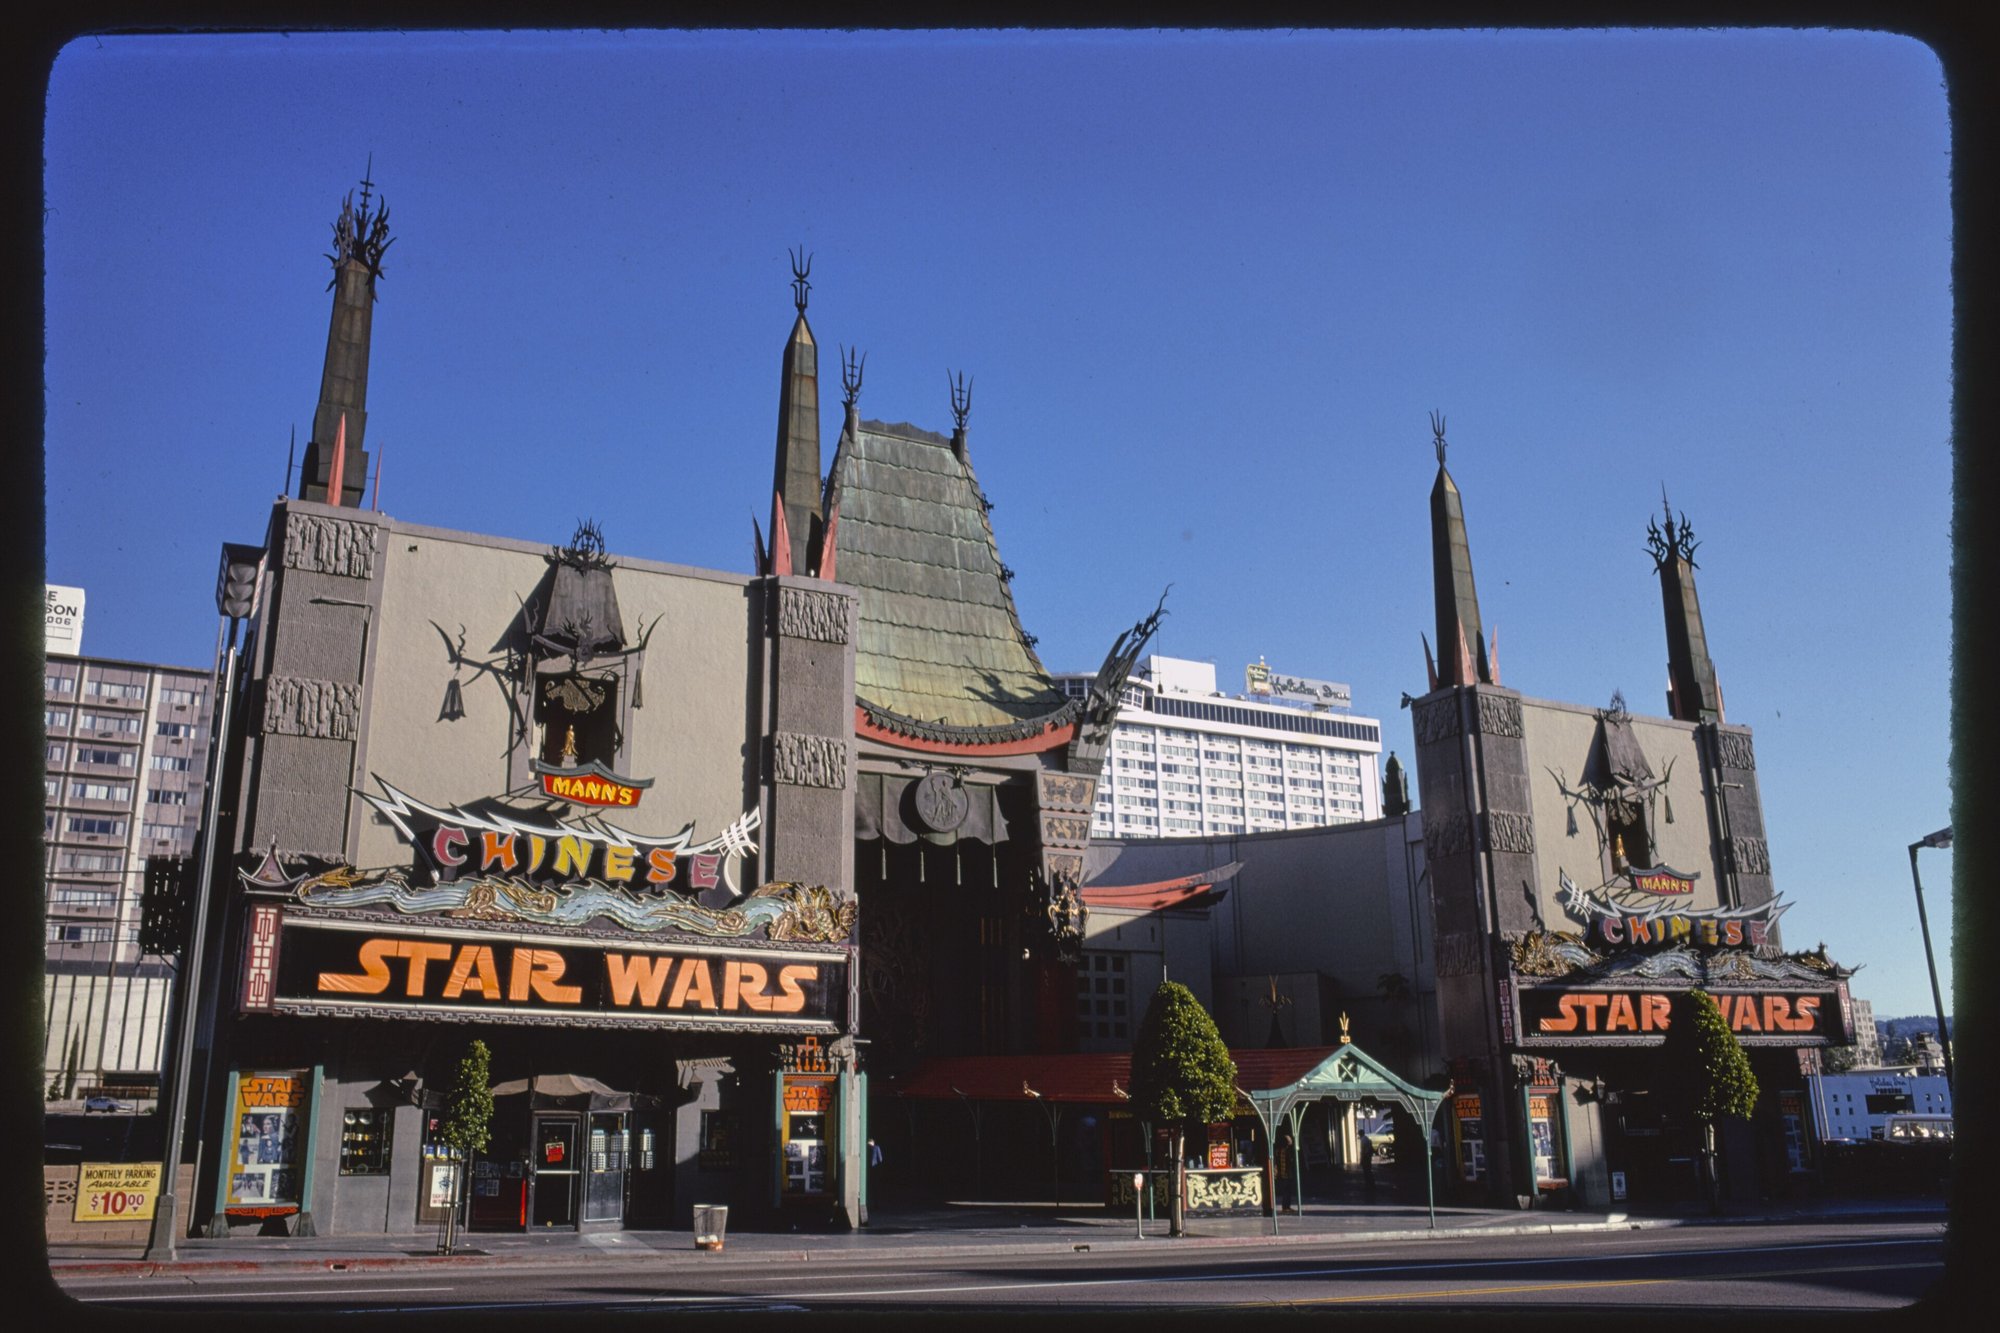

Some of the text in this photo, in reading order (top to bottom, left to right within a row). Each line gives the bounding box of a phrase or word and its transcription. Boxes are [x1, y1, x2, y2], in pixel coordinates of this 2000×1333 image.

[1269, 675, 1350, 701] Holiday Inn
[552, 775, 633, 806] MANN'S
[432, 822, 722, 890] CHINESE
[1641, 877, 1690, 893] MANN'S
[1602, 914, 1769, 946] CHINESE
[317, 938, 819, 1014] STAR WARS
[1540, 994, 1672, 1032] STAR
[241, 1078, 305, 1092] STAR
[784, 1086, 830, 1099] STAR
[243, 1092, 305, 1108] WARS
[784, 1098, 830, 1112] WARS
[86, 1169, 156, 1179] MONTHLY PARKING
